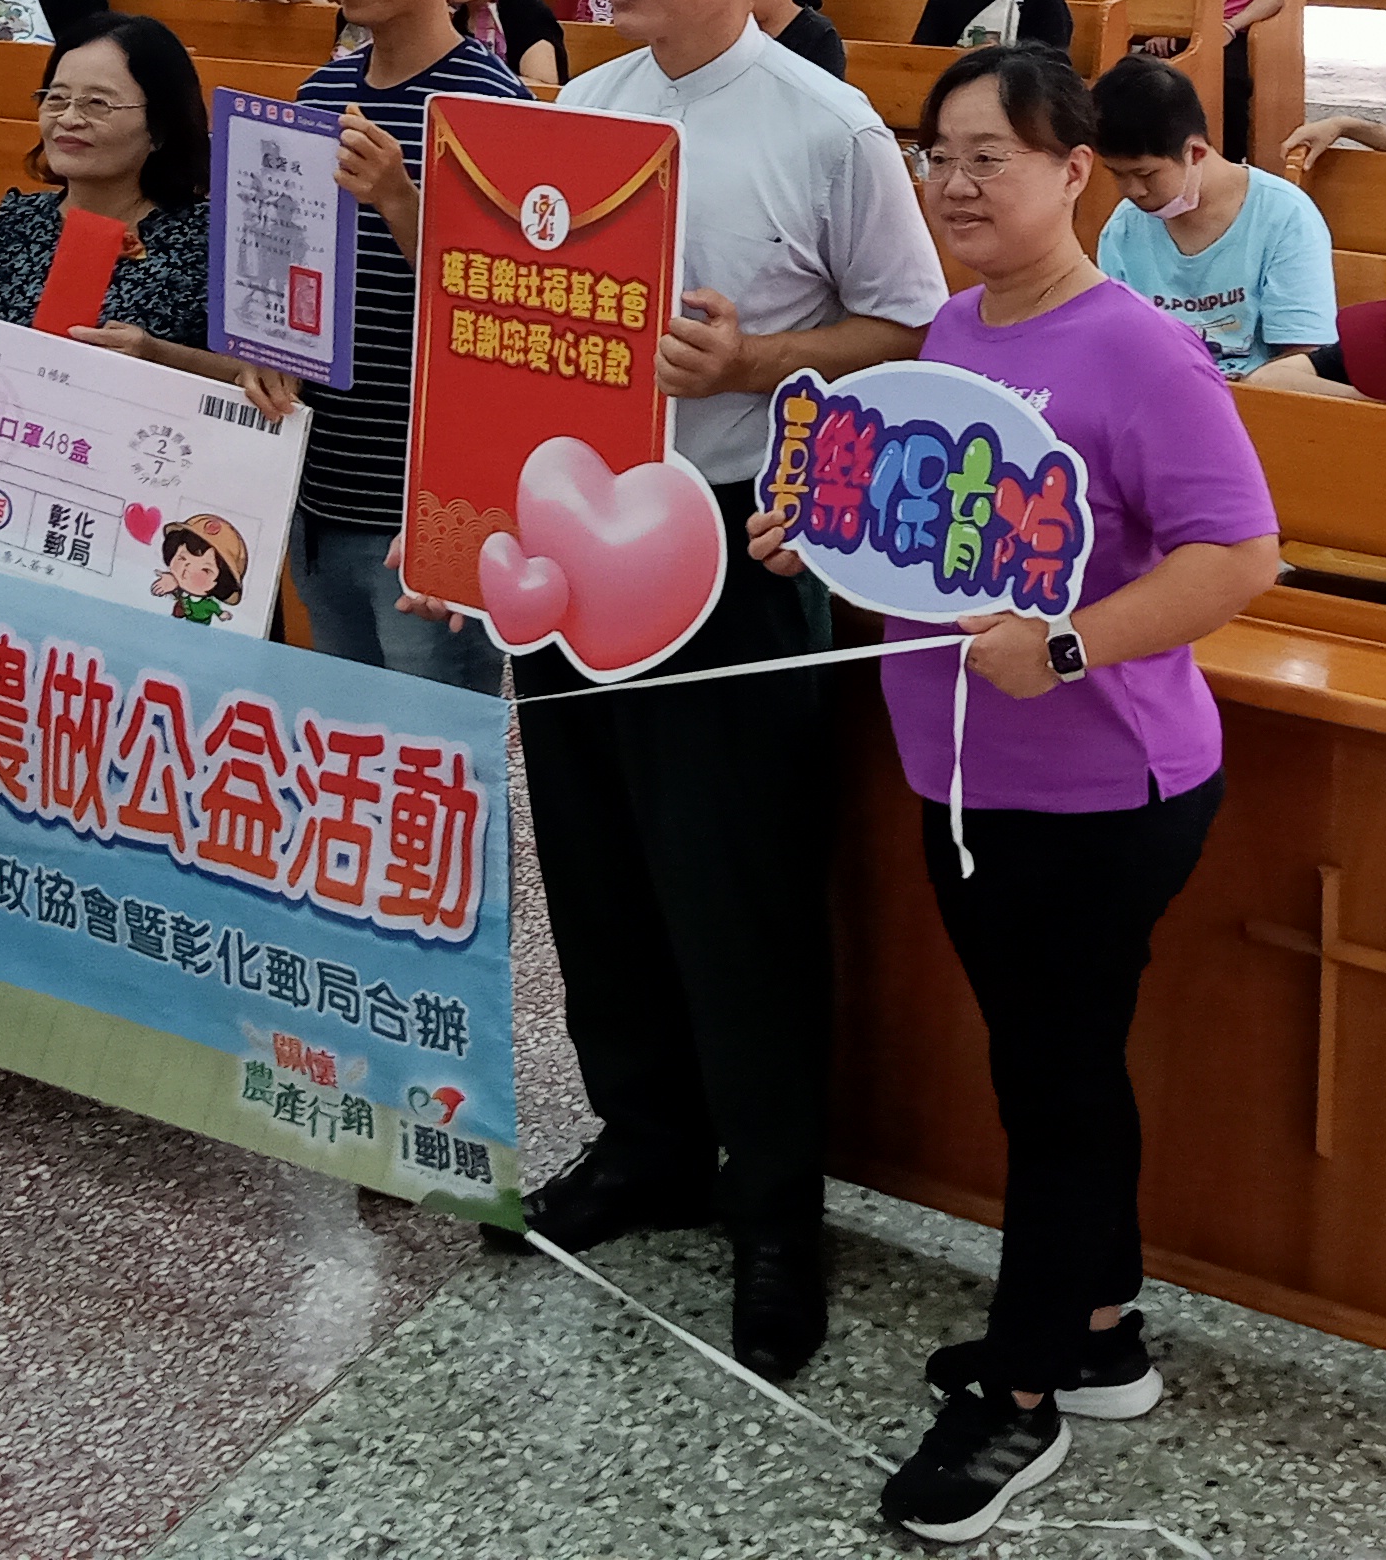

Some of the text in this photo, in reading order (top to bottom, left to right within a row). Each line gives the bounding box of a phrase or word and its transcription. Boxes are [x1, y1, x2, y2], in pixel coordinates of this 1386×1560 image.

[441, 249, 650, 330] 瑪喜樂社福基金會
[449, 307, 632, 388] 感謝您愛心捐款
[47, 503, 96, 539] 彰化
[767, 390, 1075, 601] 喜樂保育院
[42, 529, 92, 568] 郵局
